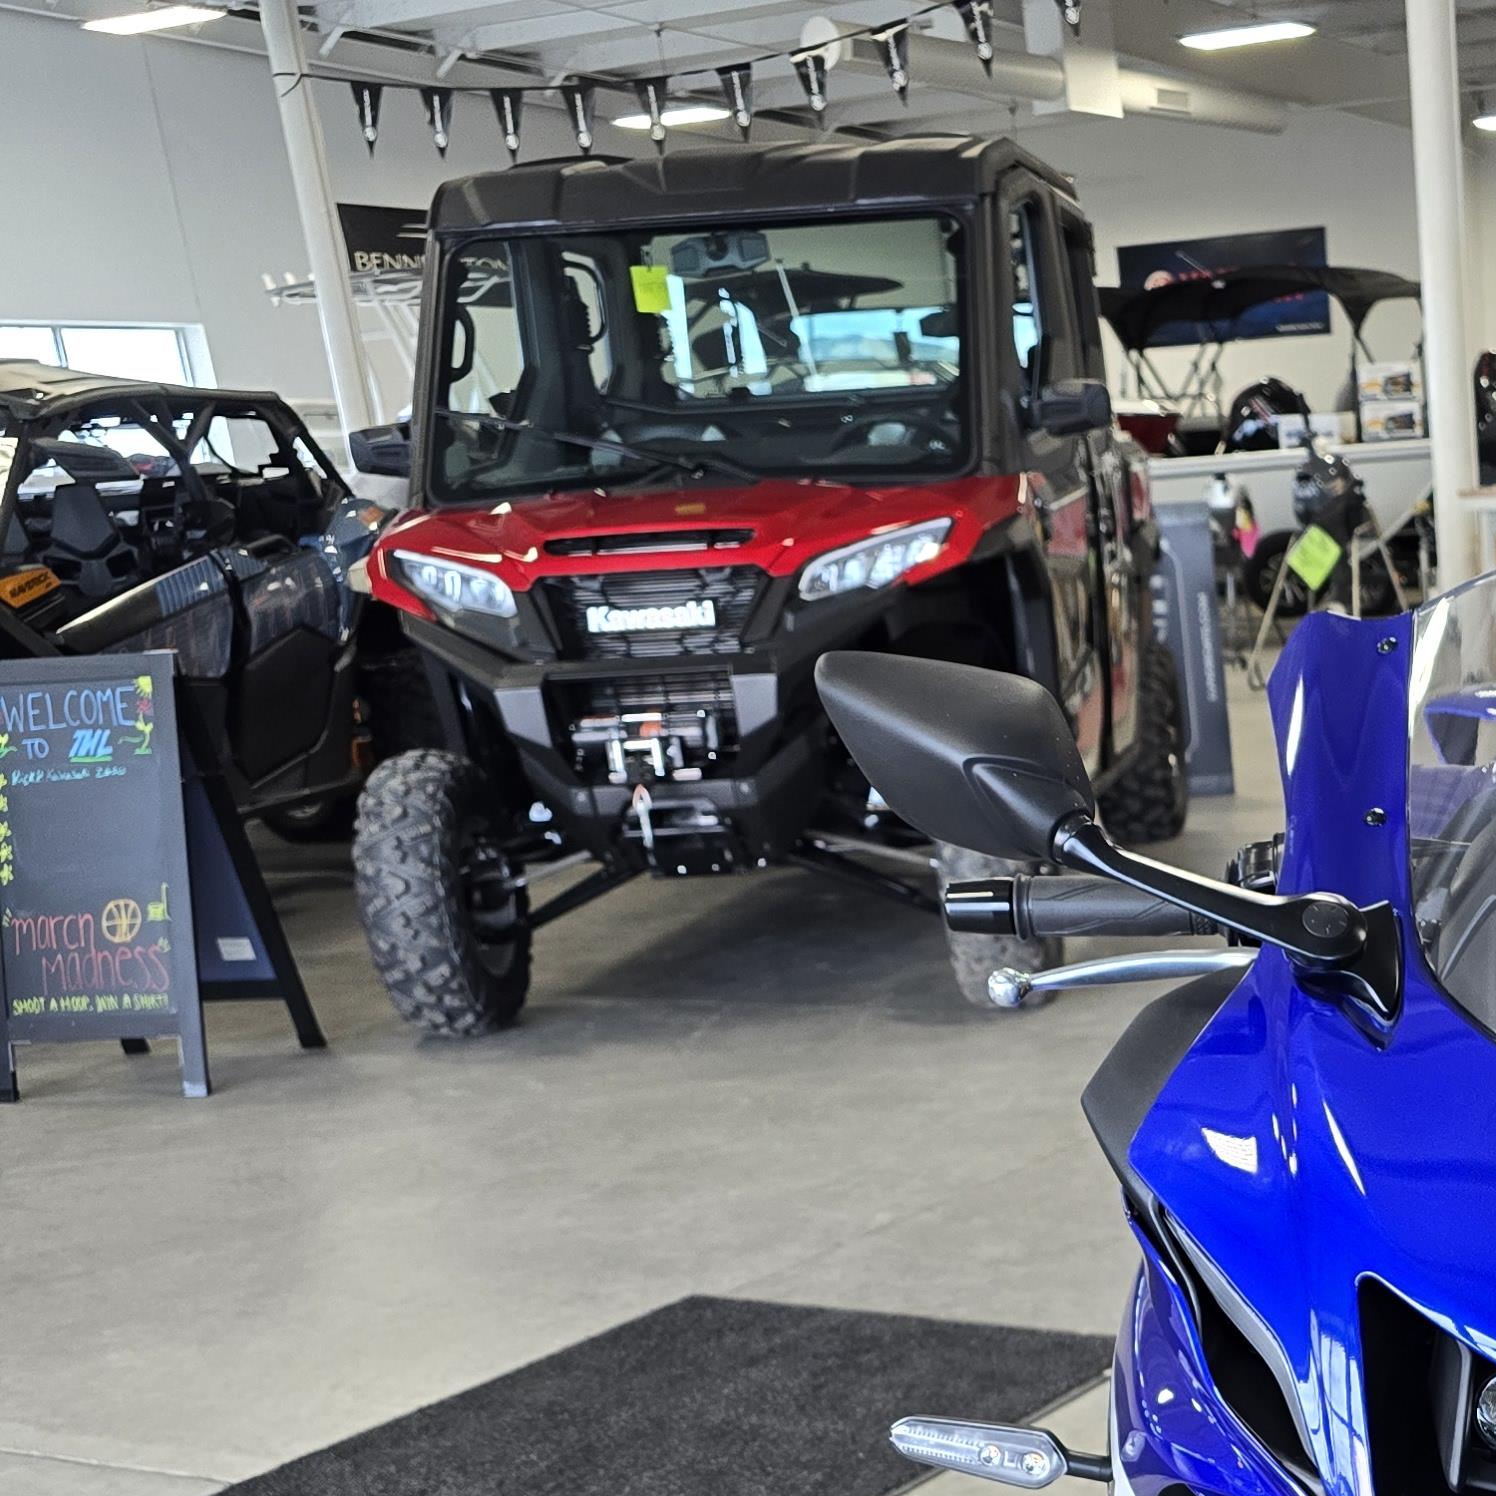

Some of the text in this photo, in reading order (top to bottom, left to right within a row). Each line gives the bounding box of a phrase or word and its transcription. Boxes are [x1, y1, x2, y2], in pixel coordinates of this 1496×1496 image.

[586, 600, 715, 633] Kawasaki
[0, 686, 136, 732] WELCOME
[22, 737, 49, 760] TO
